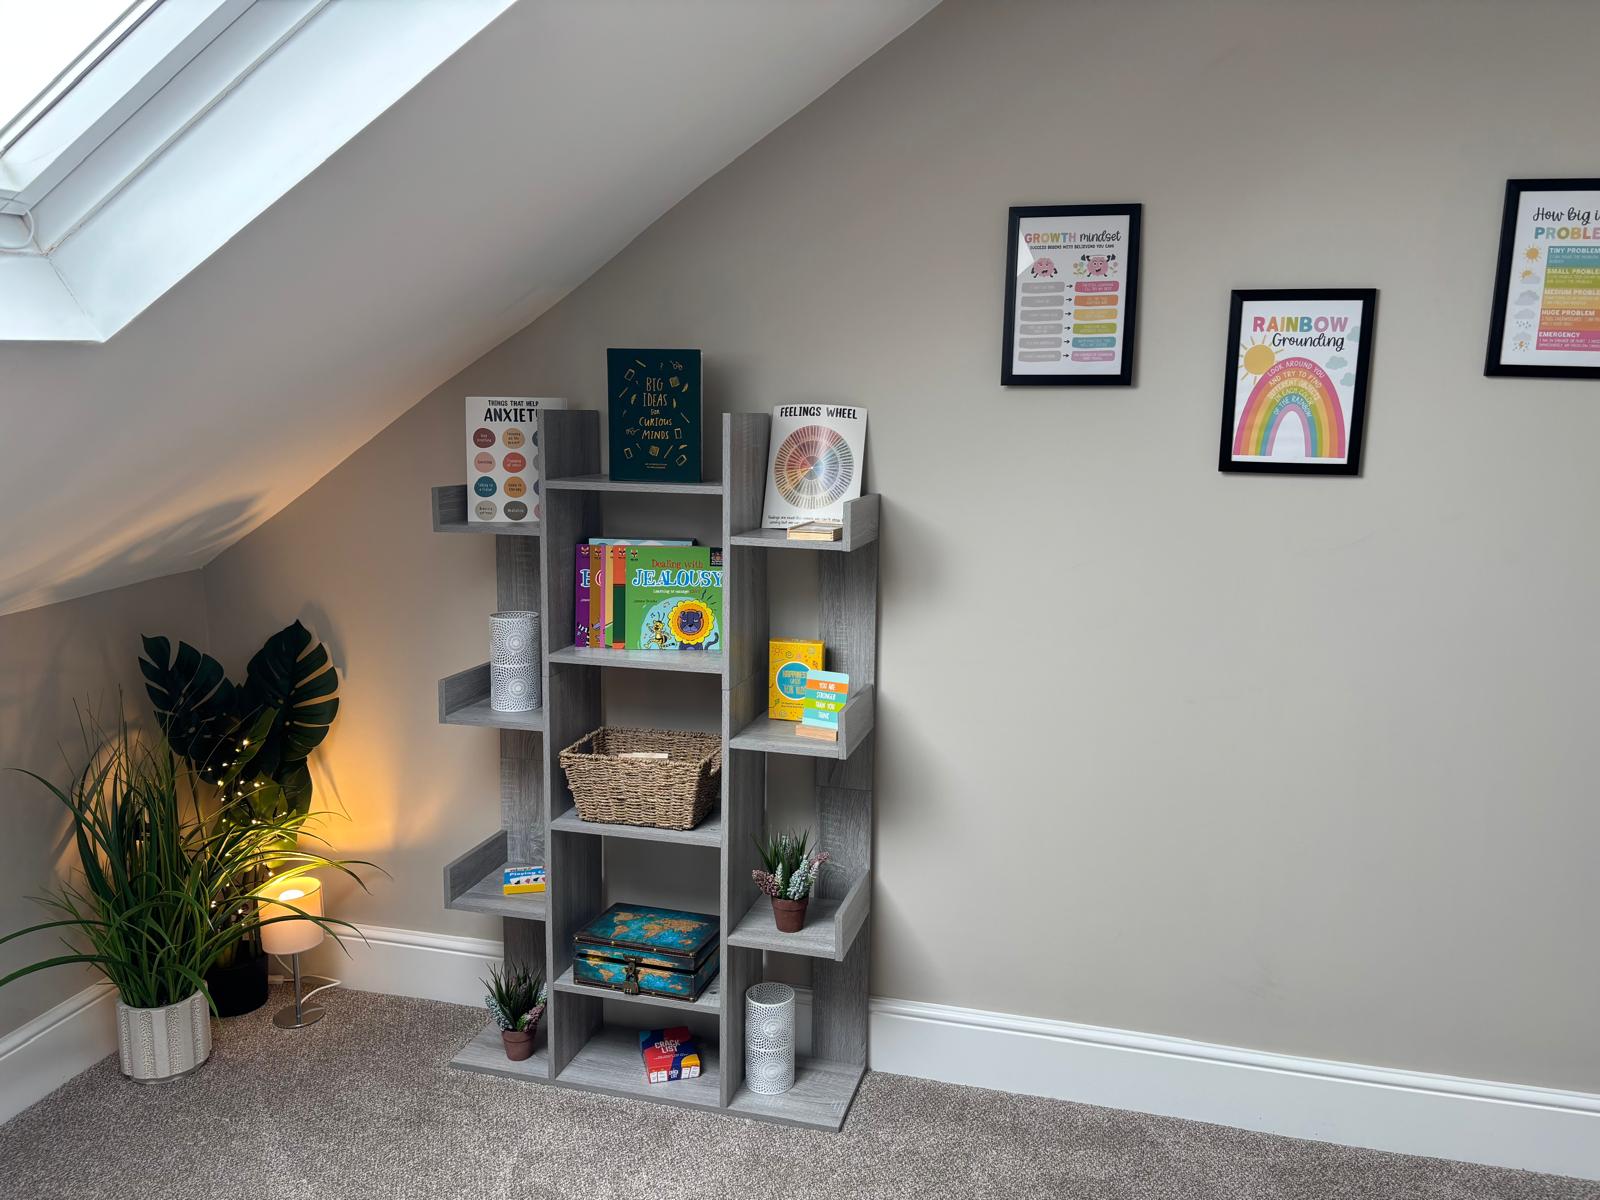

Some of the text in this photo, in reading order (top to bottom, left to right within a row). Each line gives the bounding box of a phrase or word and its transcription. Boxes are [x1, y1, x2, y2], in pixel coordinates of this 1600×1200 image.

[1533, 207, 1565, 222] How
[1568, 206, 1590, 226] big
[1024, 230, 1121, 243] GROWTH mindset
[1253, 316, 1348, 332] RAINBOW
[1272, 332, 1345, 352] Grounding
[1268, 361, 1326, 378] LOOK AROUND YOU
[646, 377, 664, 392] BIG
[643, 392, 667, 407] IDEAS
[484, 408, 538, 422] ANXIET
[780, 406, 858, 420] FEELINGS WHEEL
[642, 430, 669, 440] MINDS
[652, 559, 681, 569] Dealing
[632, 569, 723, 587] JEALOUSY
[654, 1040, 681, 1049] CRACK
[661, 1046, 678, 1054] LIST
